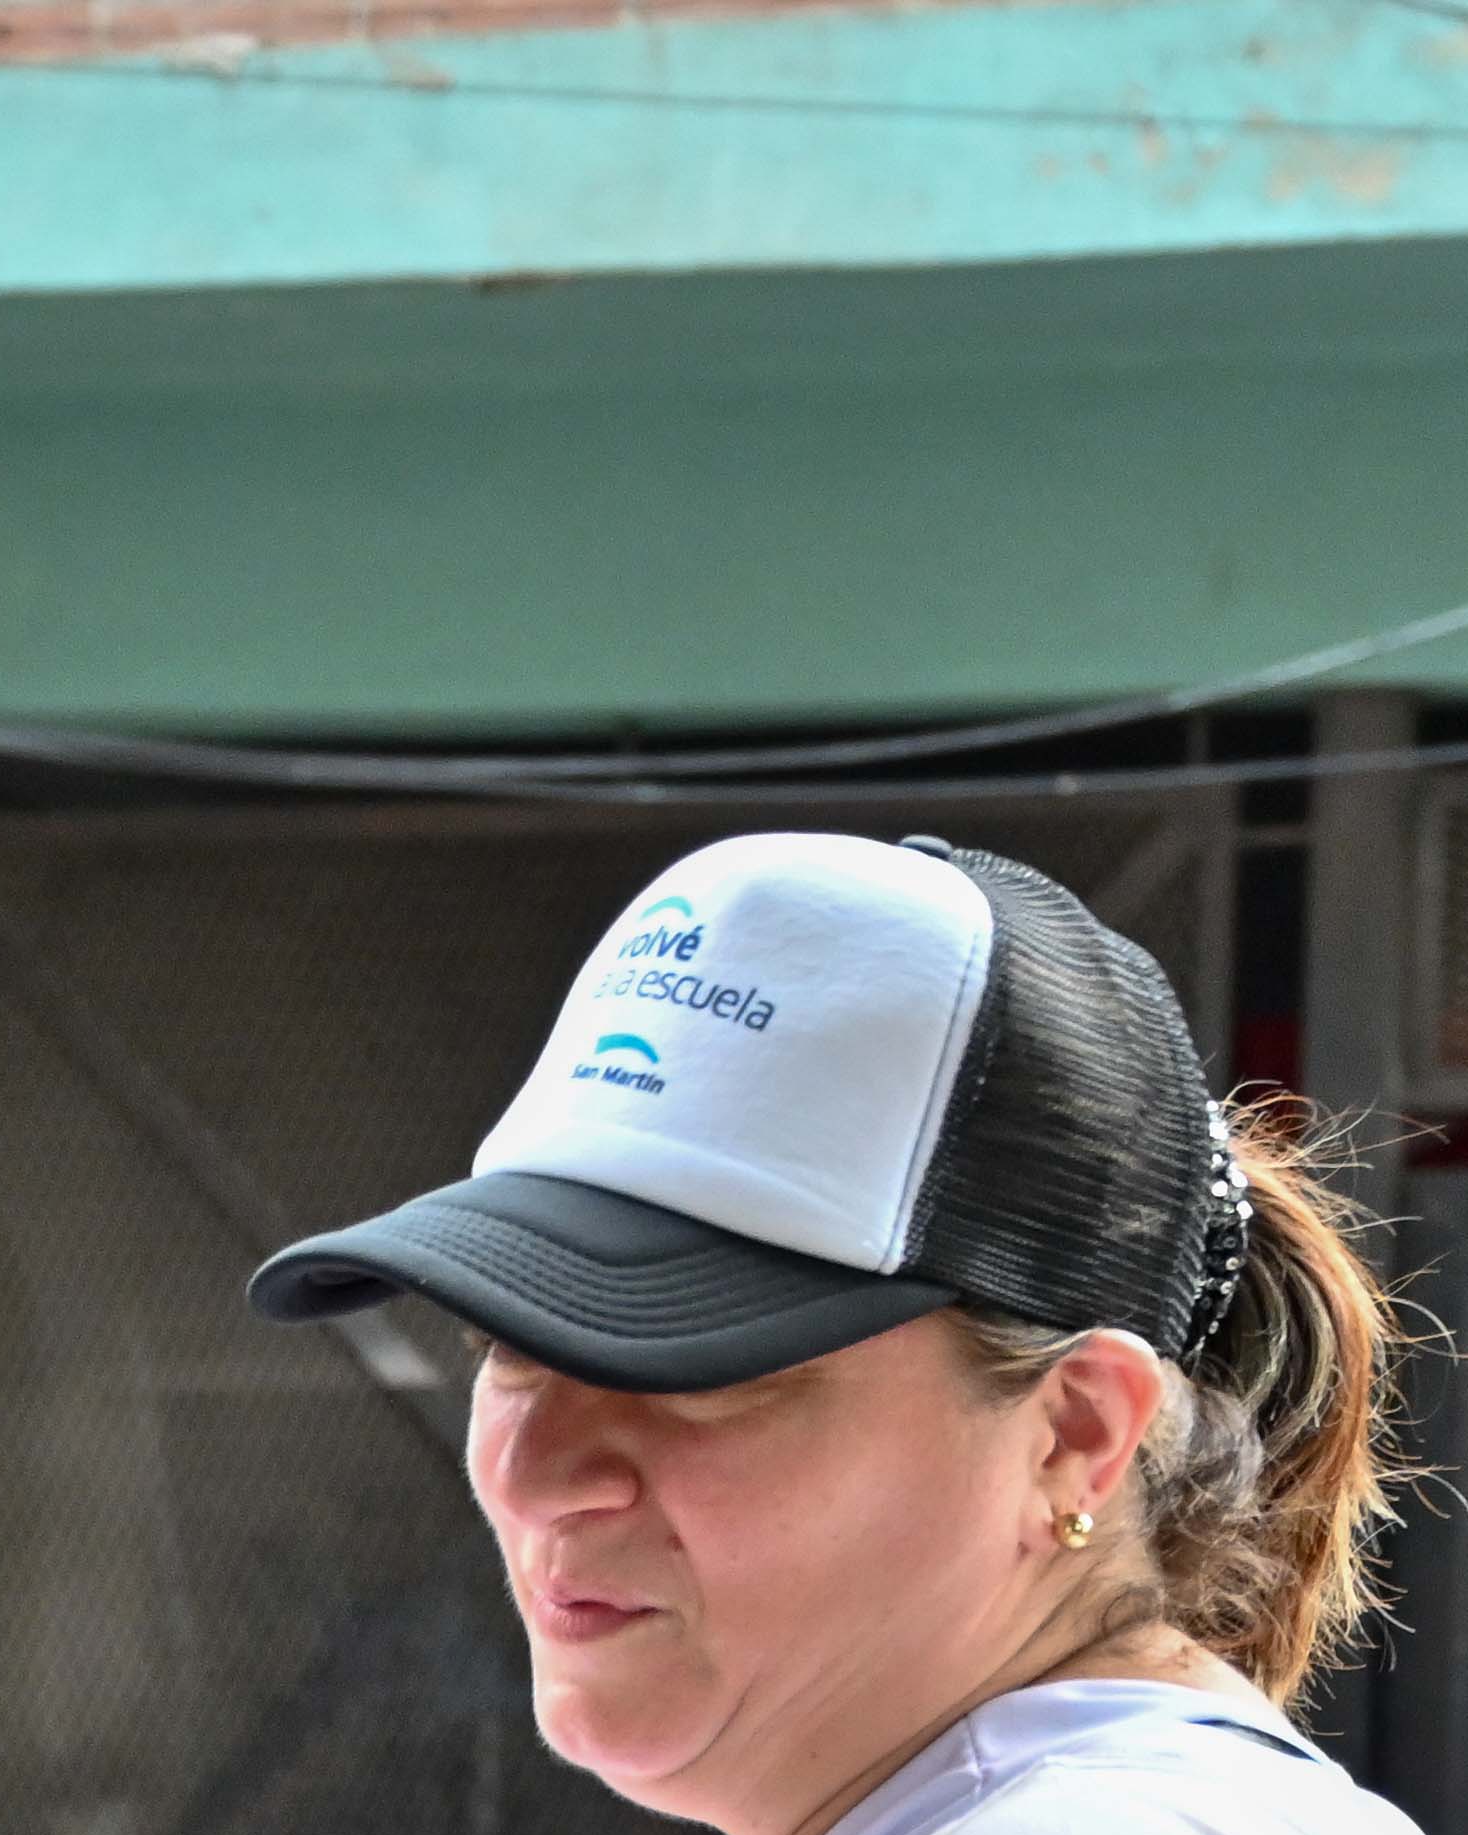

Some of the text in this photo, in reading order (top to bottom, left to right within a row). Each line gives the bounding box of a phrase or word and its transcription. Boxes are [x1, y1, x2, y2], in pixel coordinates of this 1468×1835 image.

[618, 925, 704, 961] volvé
[637, 970, 775, 1032] escuela
[571, 1062, 666, 1095] San Martín
